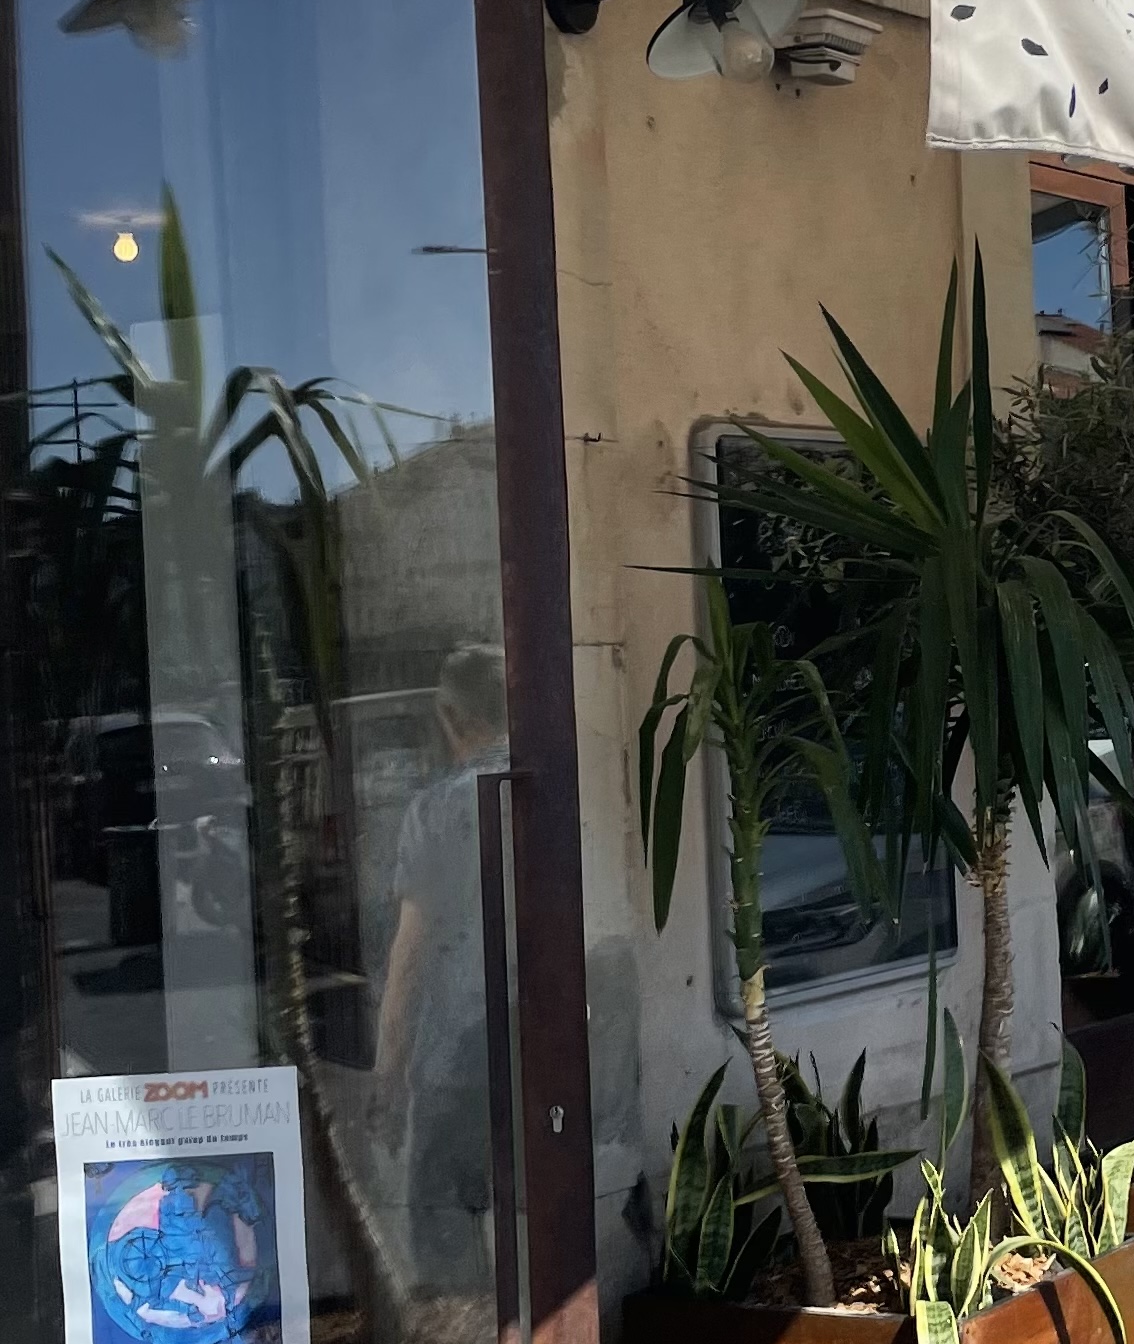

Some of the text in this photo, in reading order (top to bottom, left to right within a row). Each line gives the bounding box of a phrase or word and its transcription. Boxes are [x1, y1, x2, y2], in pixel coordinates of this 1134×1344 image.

[80, 1087, 92, 1104] LA
[97, 1084, 142, 1103] GALERIE
[143, 1079, 209, 1103] ZOOM
[62, 1106, 175, 1138] JEAN-MARC
